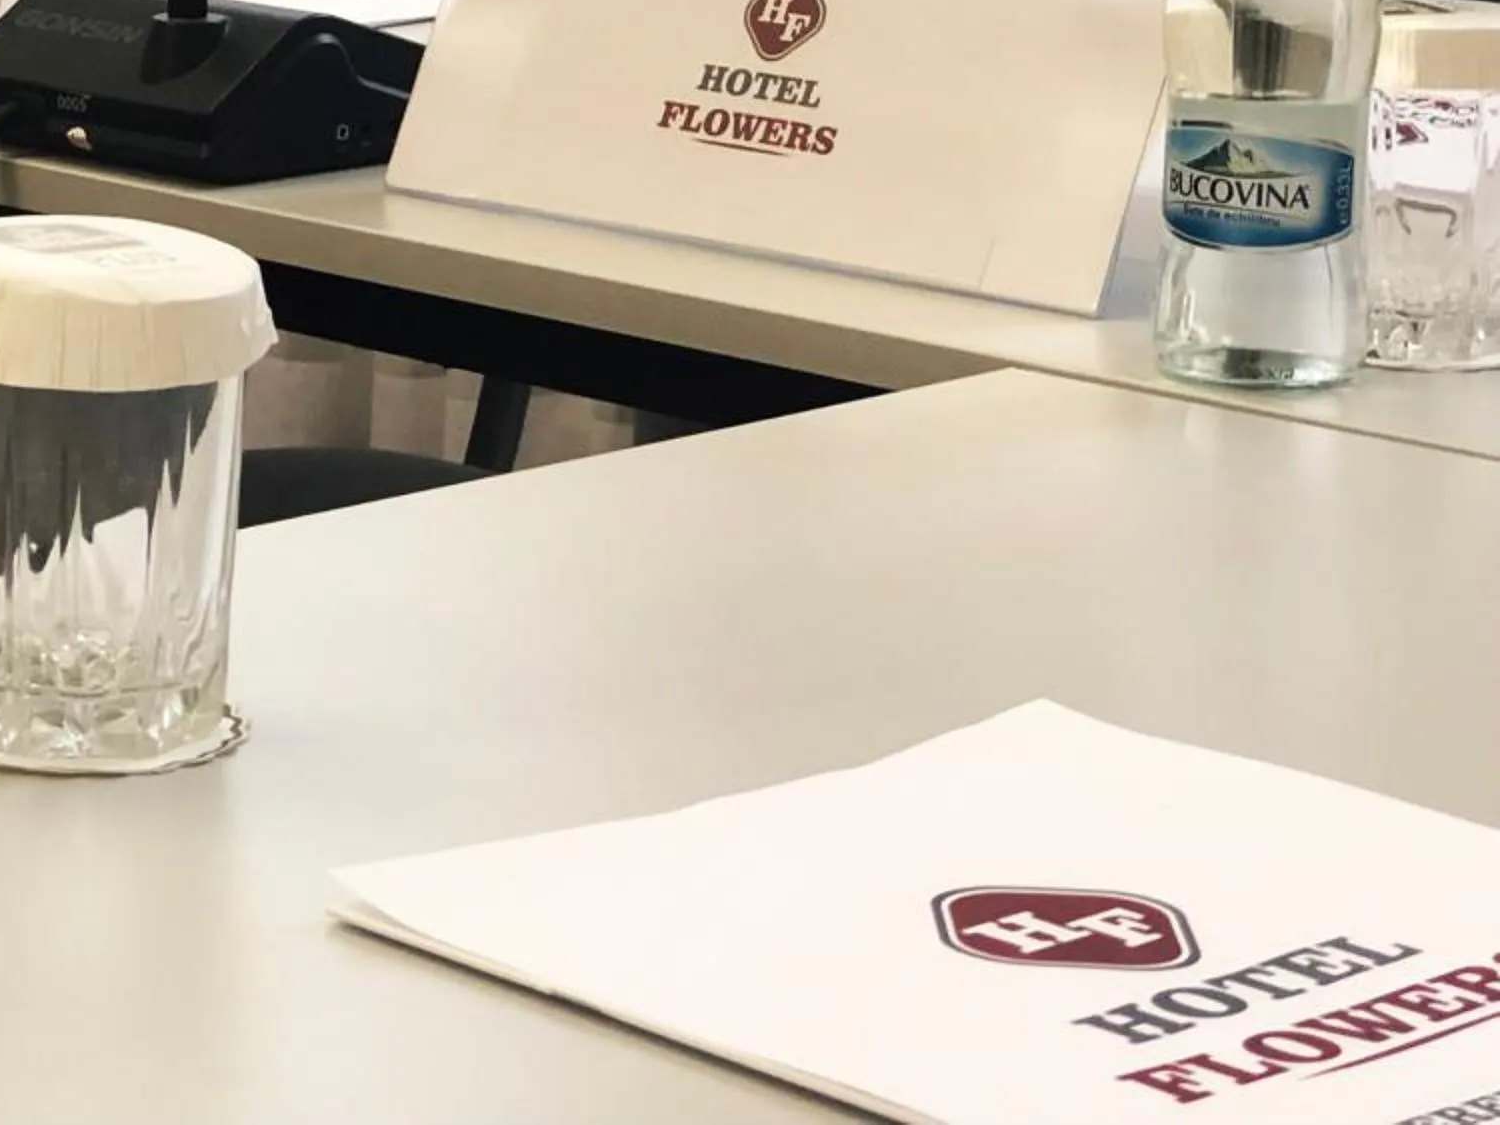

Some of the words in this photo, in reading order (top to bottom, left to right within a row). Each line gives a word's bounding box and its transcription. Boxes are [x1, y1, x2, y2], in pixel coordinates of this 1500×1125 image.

[697, 63, 822, 108] HOTEL
[656, 100, 839, 156] FLOWERS
[1169, 168, 1311, 210] BUCOVINA
[1070, 936, 1424, 1044] HOTEL
[1114, 951, 1500, 1104] FLOWER
